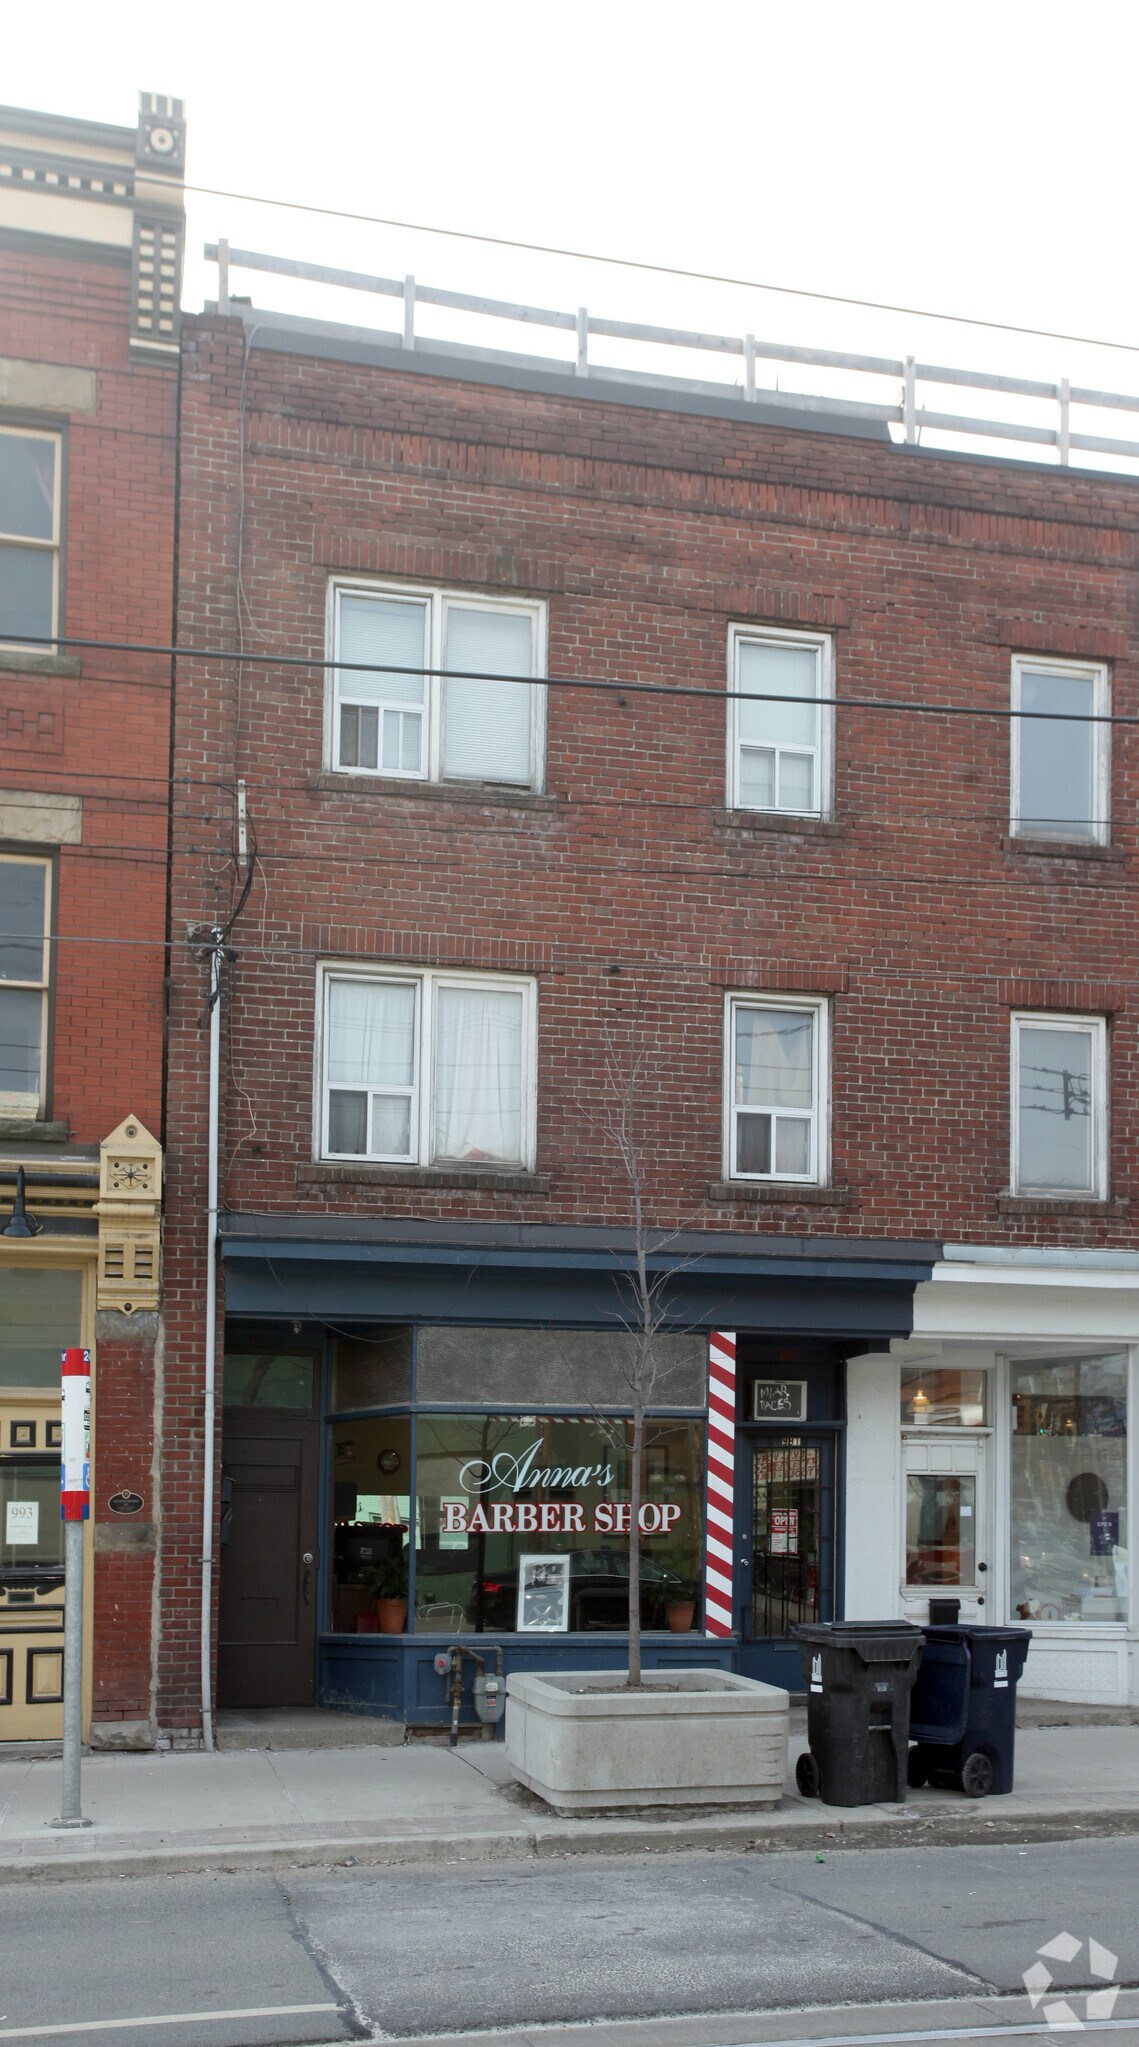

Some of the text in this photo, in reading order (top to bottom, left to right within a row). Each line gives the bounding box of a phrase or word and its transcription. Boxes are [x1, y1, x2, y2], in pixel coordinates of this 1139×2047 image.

[459, 1438, 615, 1494] Anna's
[11, 1506, 33, 1519] 993
[442, 1502, 682, 1533] BARBER SHOP
